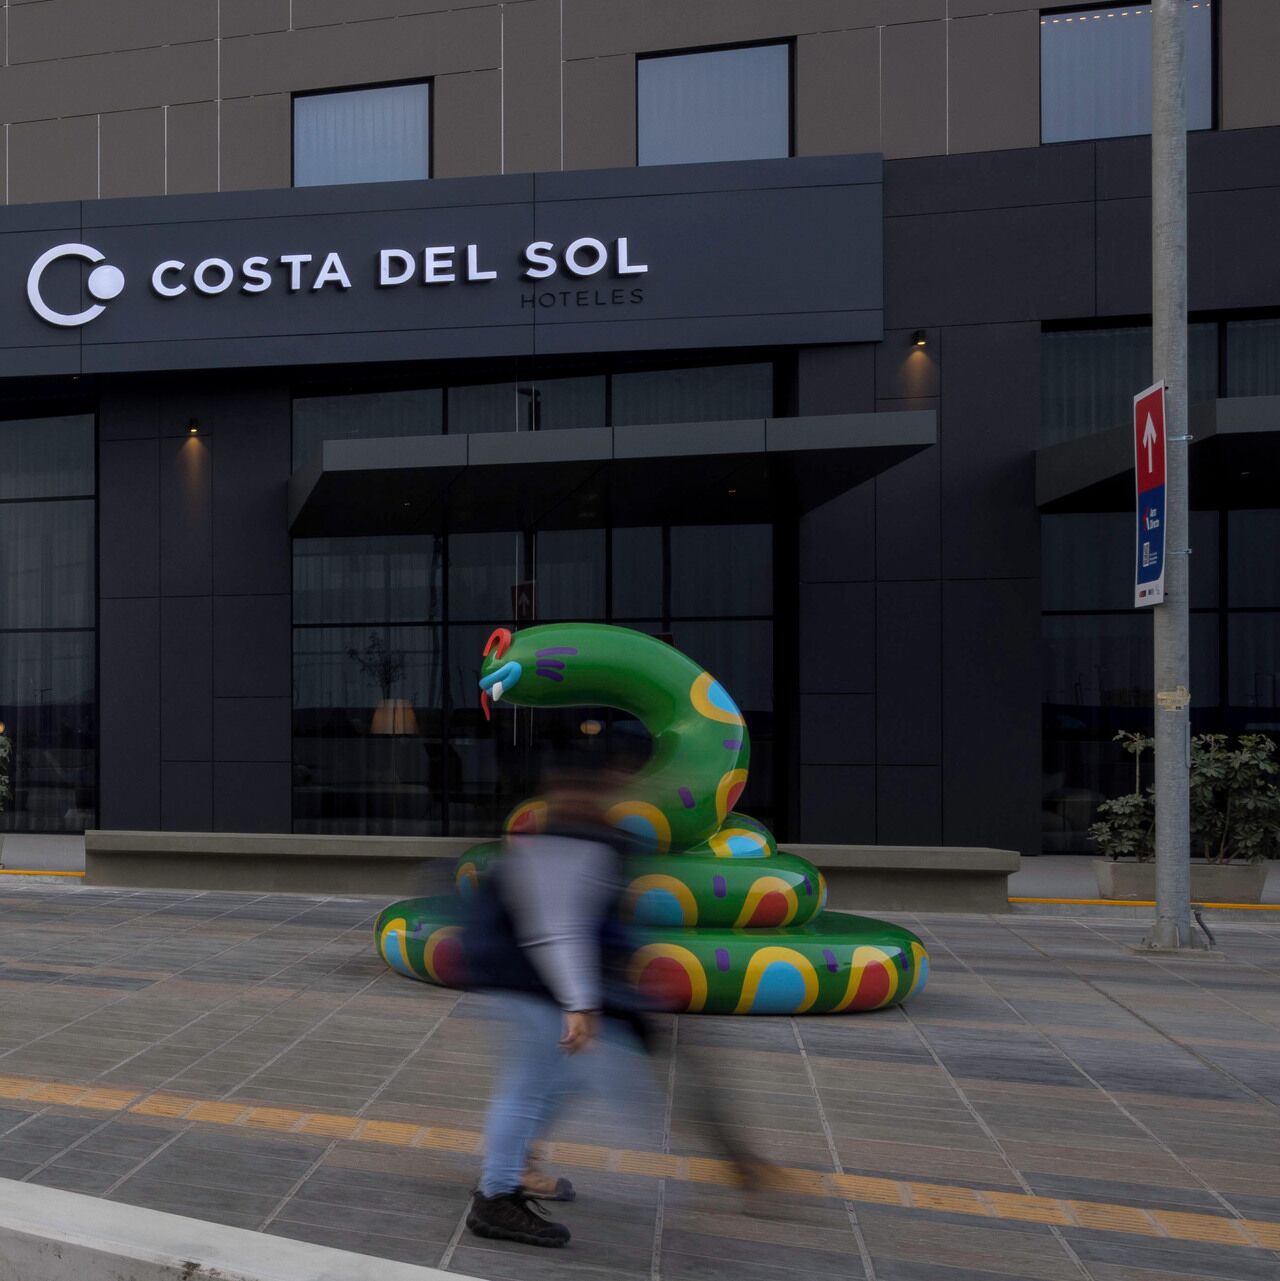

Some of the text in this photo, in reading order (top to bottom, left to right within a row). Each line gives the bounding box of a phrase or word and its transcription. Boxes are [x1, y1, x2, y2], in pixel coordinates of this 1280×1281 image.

[151, 237, 649, 297] COSTA DEL SOL
[521, 288, 644, 309] HOTELES
